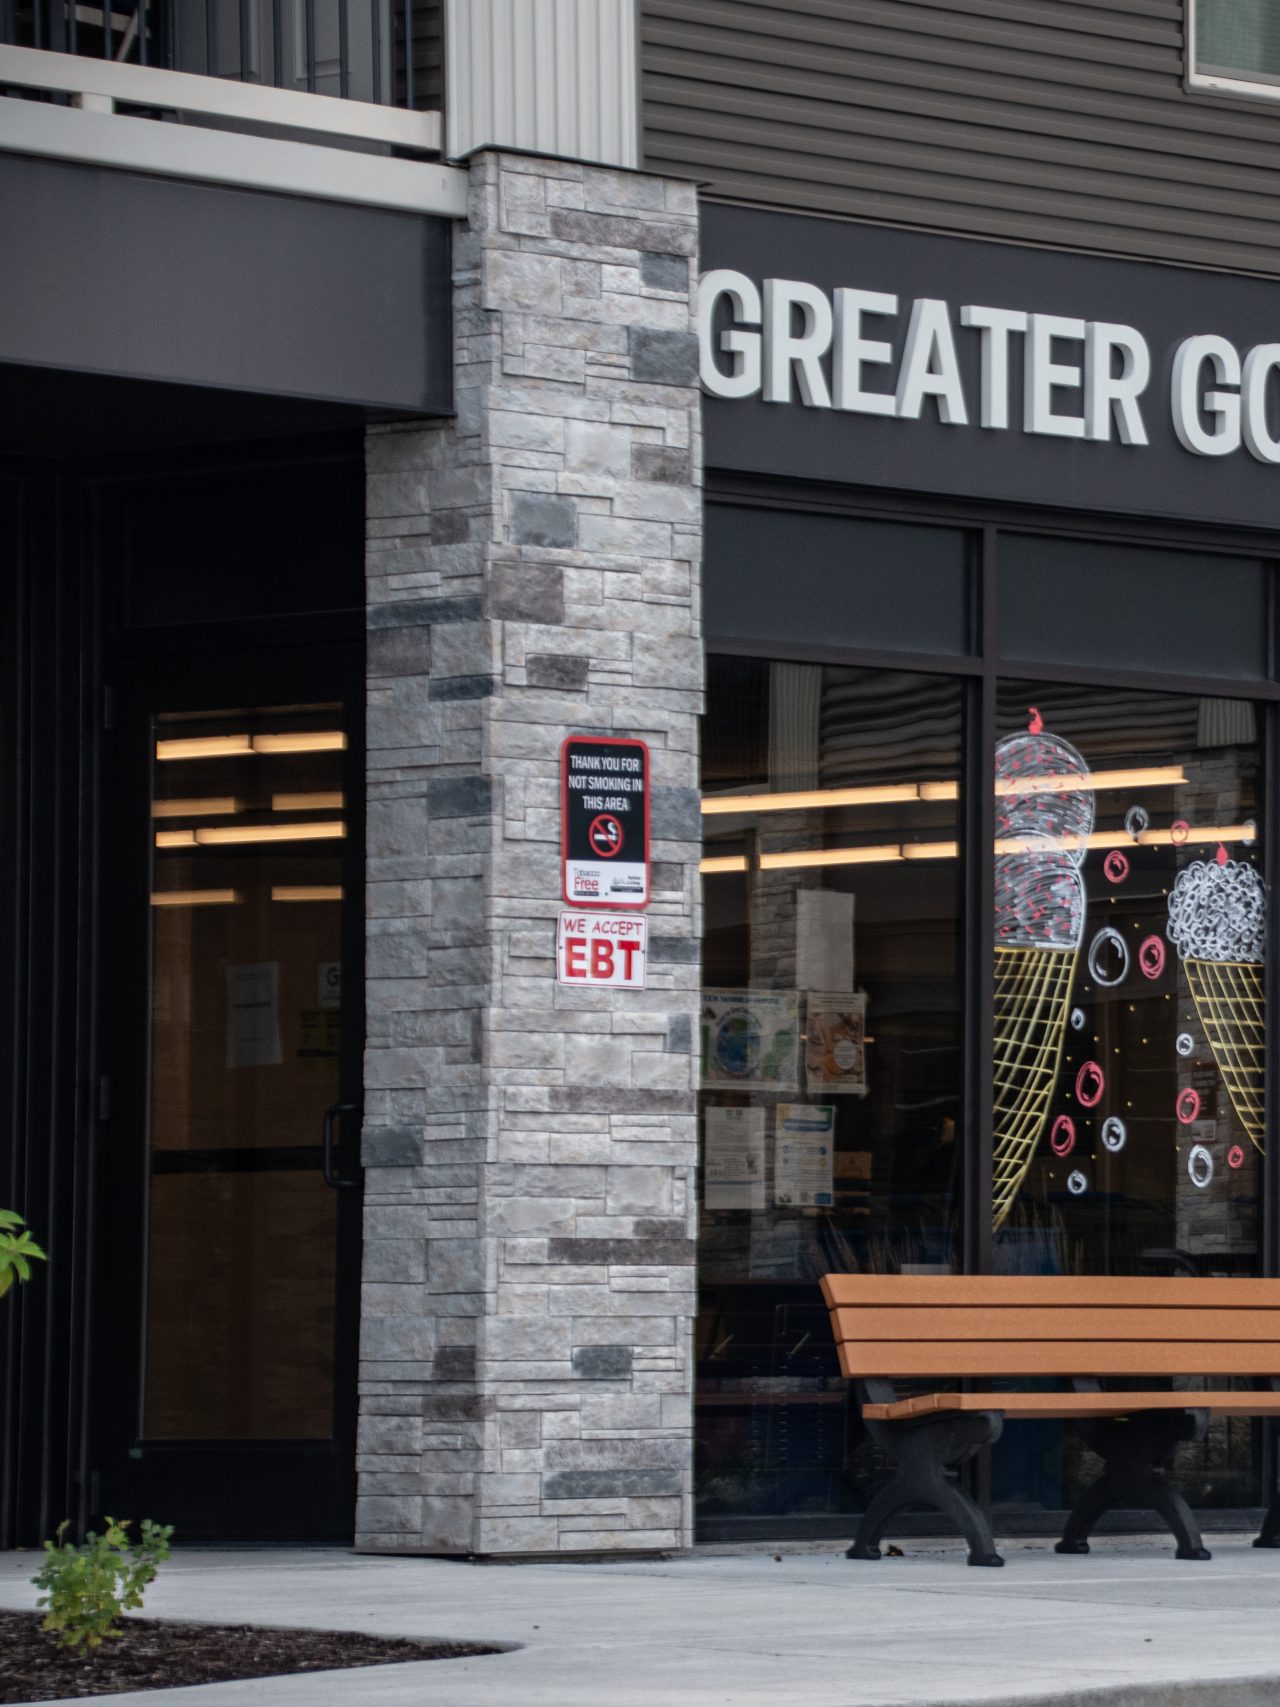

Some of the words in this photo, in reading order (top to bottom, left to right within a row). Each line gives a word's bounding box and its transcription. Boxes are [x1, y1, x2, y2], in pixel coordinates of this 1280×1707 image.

[699, 269, 1149, 445] GREATER
[570, 755, 600, 770] THANK
[601, 757, 619, 771] YOU
[621, 758, 640, 772] FOR
[568, 775, 587, 789] NOT
[588, 776, 631, 791] SMOKING
[632, 778, 643, 792] IN
[582, 796, 603, 810] THIS
[604, 797, 630, 811] AREA
[574, 877, 599, 891] Free
[563, 918, 586, 933] WE
[592, 920, 643, 935] ACCEPT
[565, 937, 640, 980] EBT
